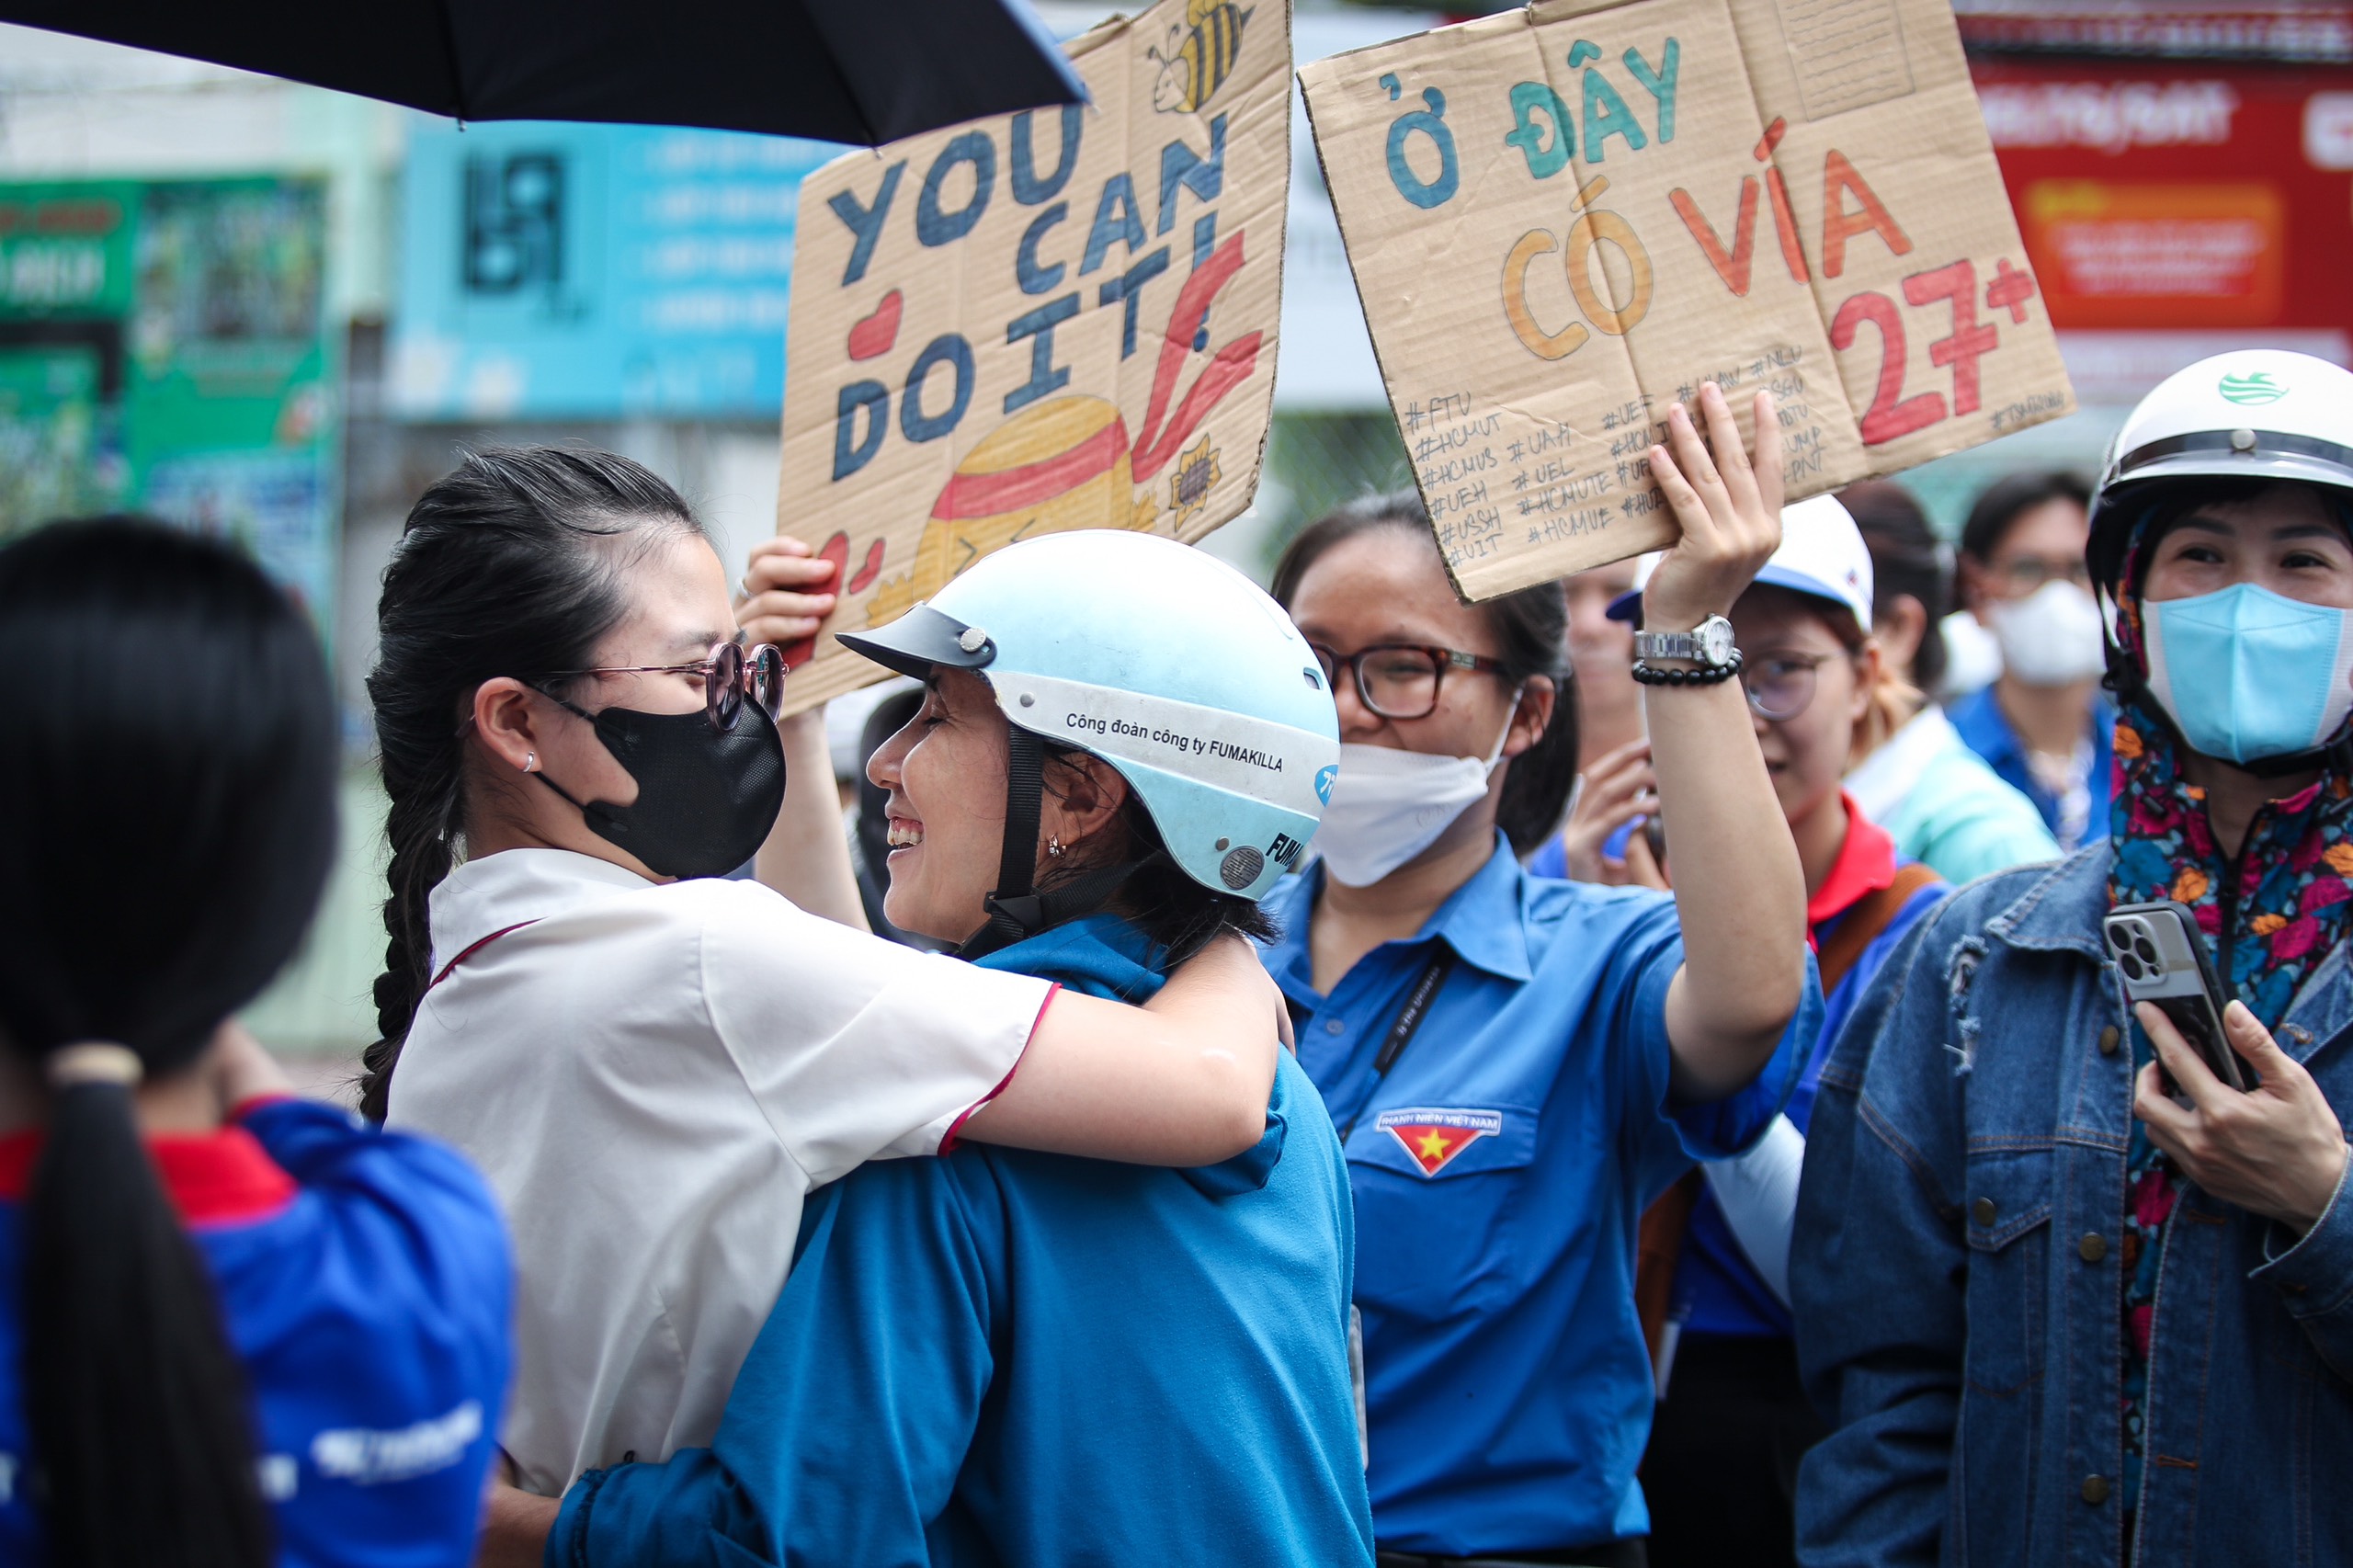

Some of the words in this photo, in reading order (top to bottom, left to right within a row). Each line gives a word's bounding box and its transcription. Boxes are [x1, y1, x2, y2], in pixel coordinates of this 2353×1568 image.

[1379, 71, 1460, 210] Ở
[1505, 36, 1680, 180] ĐÂY
[828, 104, 1084, 287] YOU
[1016, 110, 1228, 295] CAN
[1501, 174, 1654, 360] CÓ
[1668, 115, 1914, 297] VÍA
[1829, 257, 2035, 447] 27+
[833, 333, 975, 482] DO
[1405, 390, 1472, 435] #FTU
[1602, 393, 1654, 431] #UEF
[1759, 376, 1803, 403] SGU
[1415, 411, 1502, 462] #HCMUT
[1782, 425, 1822, 453] UMP
[1423, 447, 1499, 490] #HCMUS
[1432, 480, 1489, 520] #UEH
[1518, 471, 1614, 517] #HCMUTE
[1616, 457, 1654, 489] #UF
[1439, 506, 1502, 547] #USSH
[1447, 532, 1505, 568] #UIT
[1065, 712, 1107, 734] Công
[1110, 719, 1149, 739] đoàn
[1152, 728, 1190, 752] công
[1191, 736, 1208, 756] ty
[1209, 740, 1284, 773] FUMAKILLA
[1471, 1116, 1498, 1131] NAM
